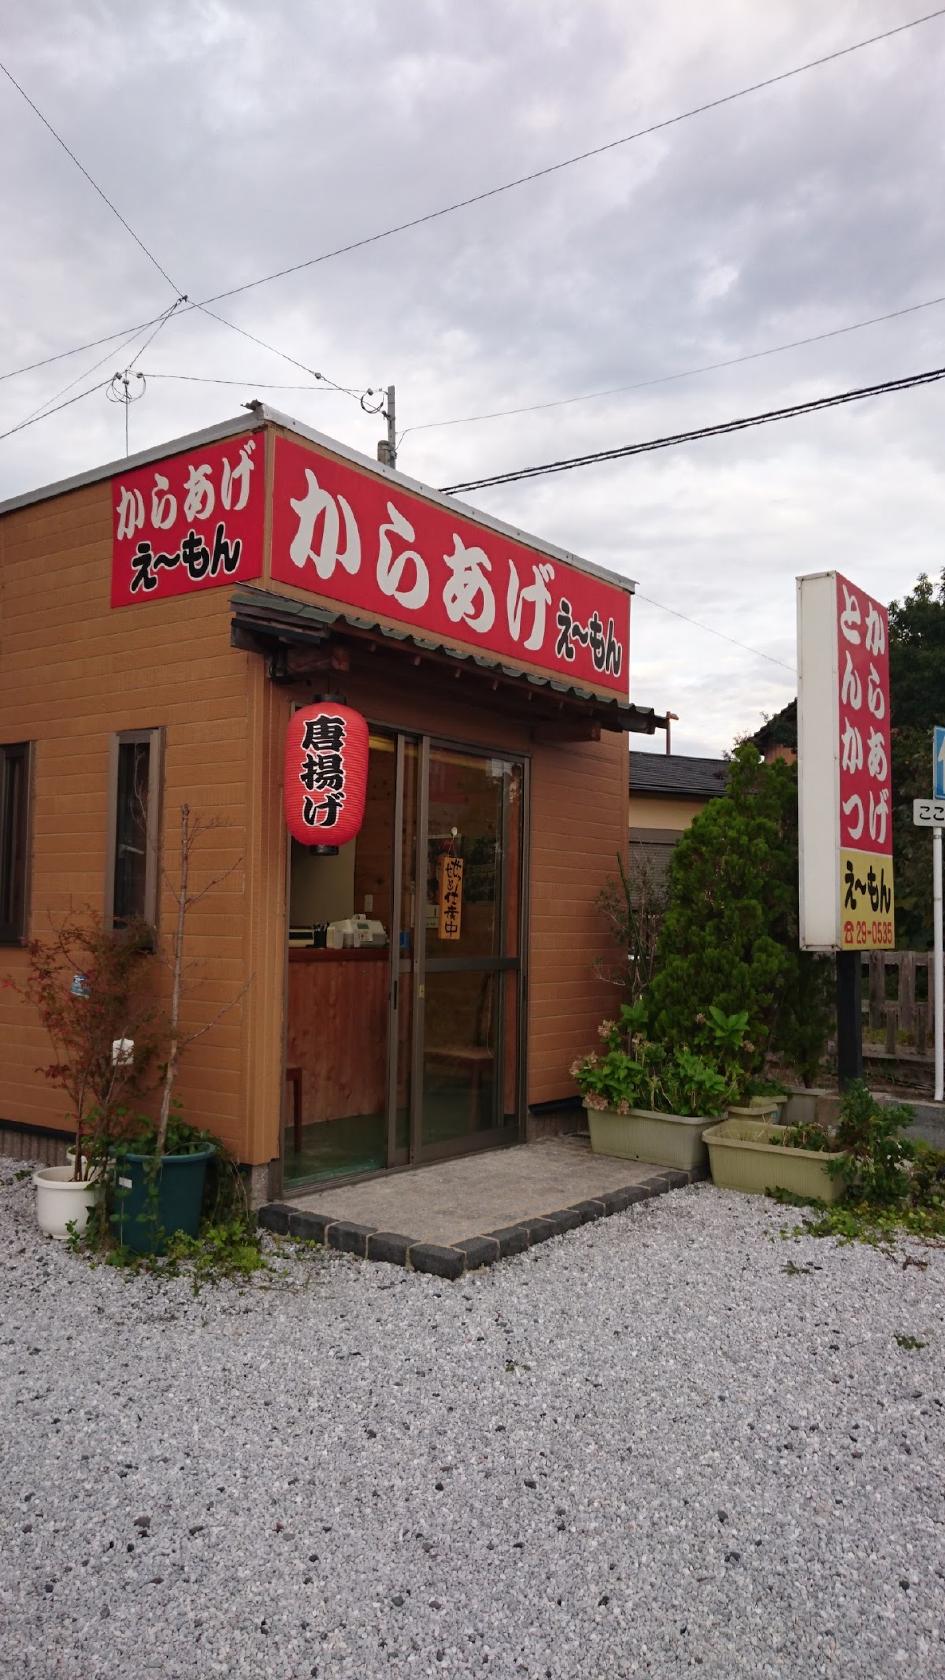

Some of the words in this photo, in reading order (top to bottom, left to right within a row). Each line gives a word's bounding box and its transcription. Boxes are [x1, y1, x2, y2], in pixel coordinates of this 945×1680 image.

[115, 440, 257, 541] からあげ
[289, 468, 555, 651] からあげ
[300, 713, 347, 829] 唐揚げ
[840, 584, 865, 841] とんかつ
[865, 602, 890, 845] からあげ
